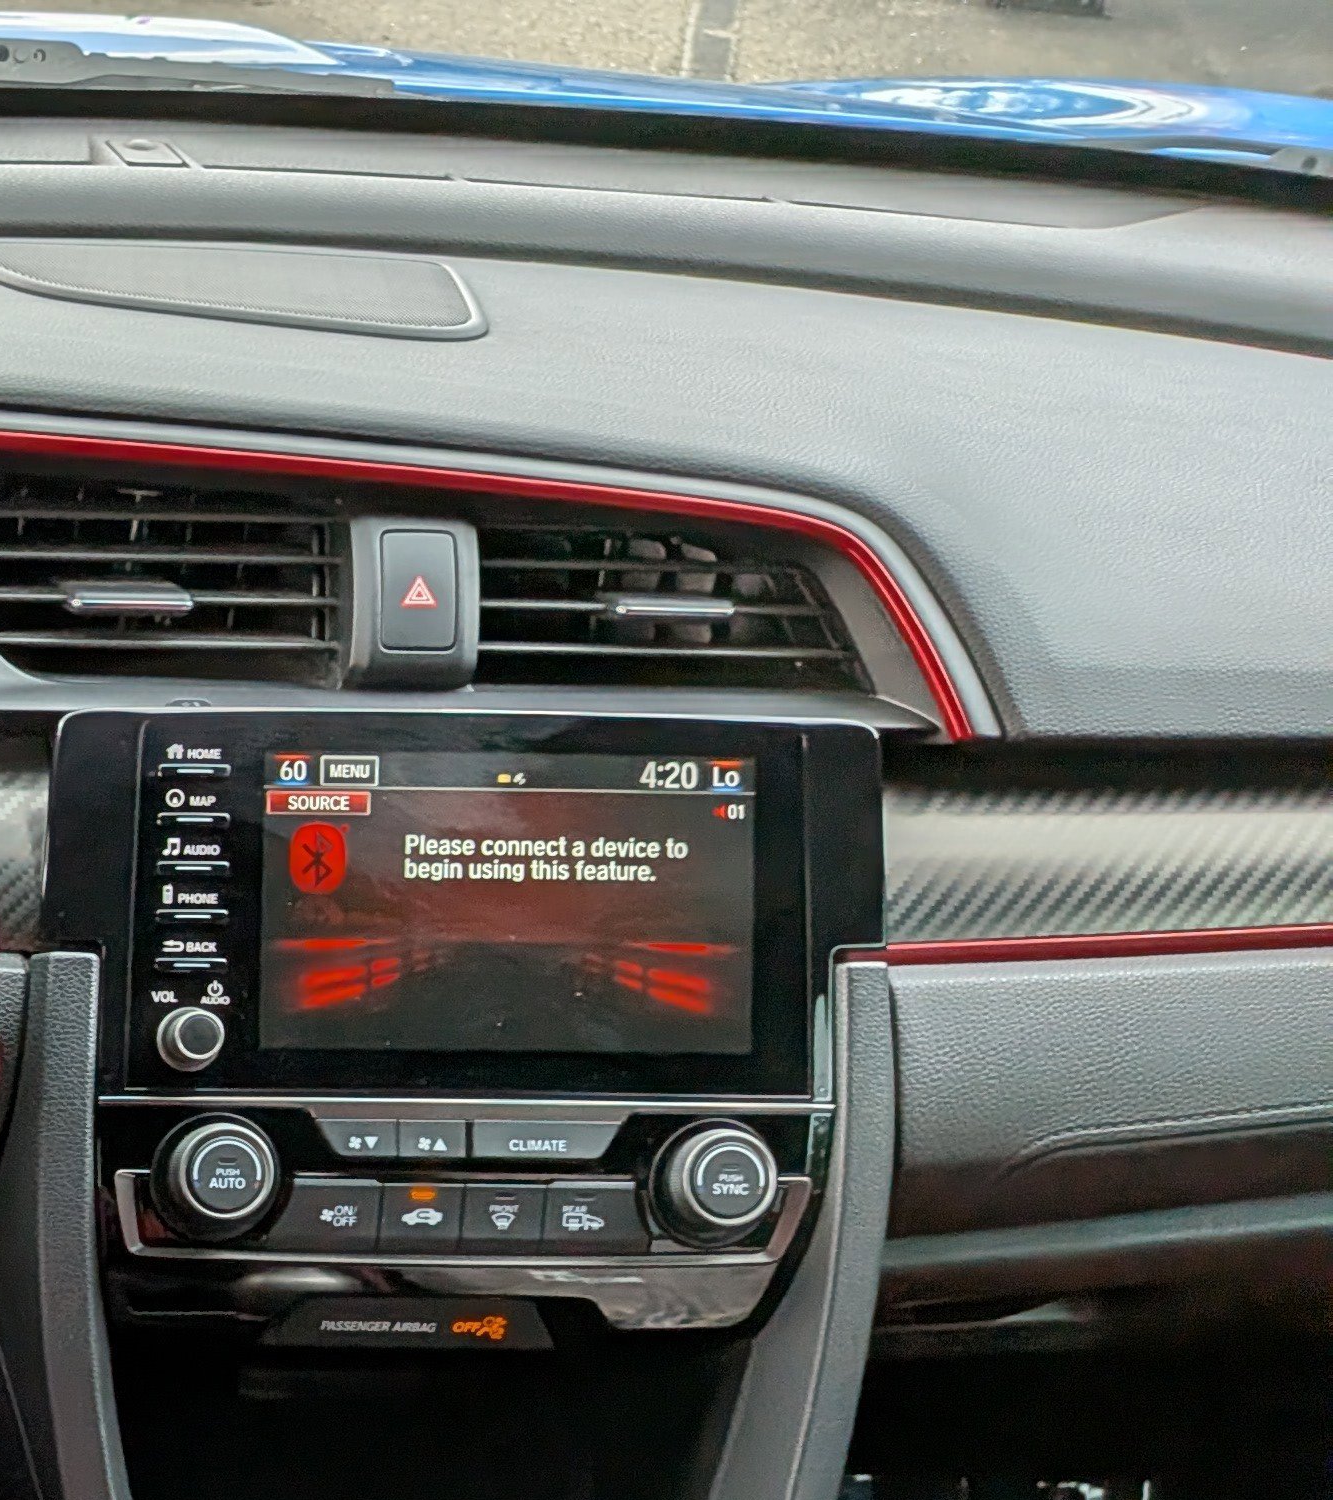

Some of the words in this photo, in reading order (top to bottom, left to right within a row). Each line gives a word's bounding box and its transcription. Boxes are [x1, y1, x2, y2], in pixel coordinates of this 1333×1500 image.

[186, 748, 222, 760] HOME
[279, 760, 308, 781] 60
[329, 763, 371, 779] MENU
[639, 761, 699, 789] 4:20
[712, 766, 741, 788] Lo
[189, 795, 217, 807] MAP
[287, 795, 351, 812] SOURCE
[726, 803, 746, 820] 01
[183, 844, 221, 856] AUDIO
[404, 834, 475, 856] Please
[480, 836, 567, 857] connect
[571, 841, 585, 858] a
[590, 837, 660, 859] device
[665, 837, 689, 859] to
[404, 857, 463, 882] begin
[468, 861, 525, 882] using
[530, 859, 570, 881] this
[575, 860, 657, 882] feature.
[177, 892, 219, 905] PHONE
[185, 941, 218, 953] BACK
[150, 990, 179, 1003] VOL
[199, 995, 231, 1006] AUDIO
[508, 1139, 567, 1152] CLIMATE
[215, 1167, 241, 1176] PUSH
[718, 1173, 744, 1183] PUSH
[208, 1177, 246, 1190] AUTO
[711, 1183, 750, 1196] SYNC
[489, 1204, 520, 1213] FRONT
[332, 1216, 358, 1228] OFF
[320, 1320, 392, 1332] PASSENGER
[391, 1321, 437, 1333] AIRBAG
[451, 1321, 481, 1333] OFF
